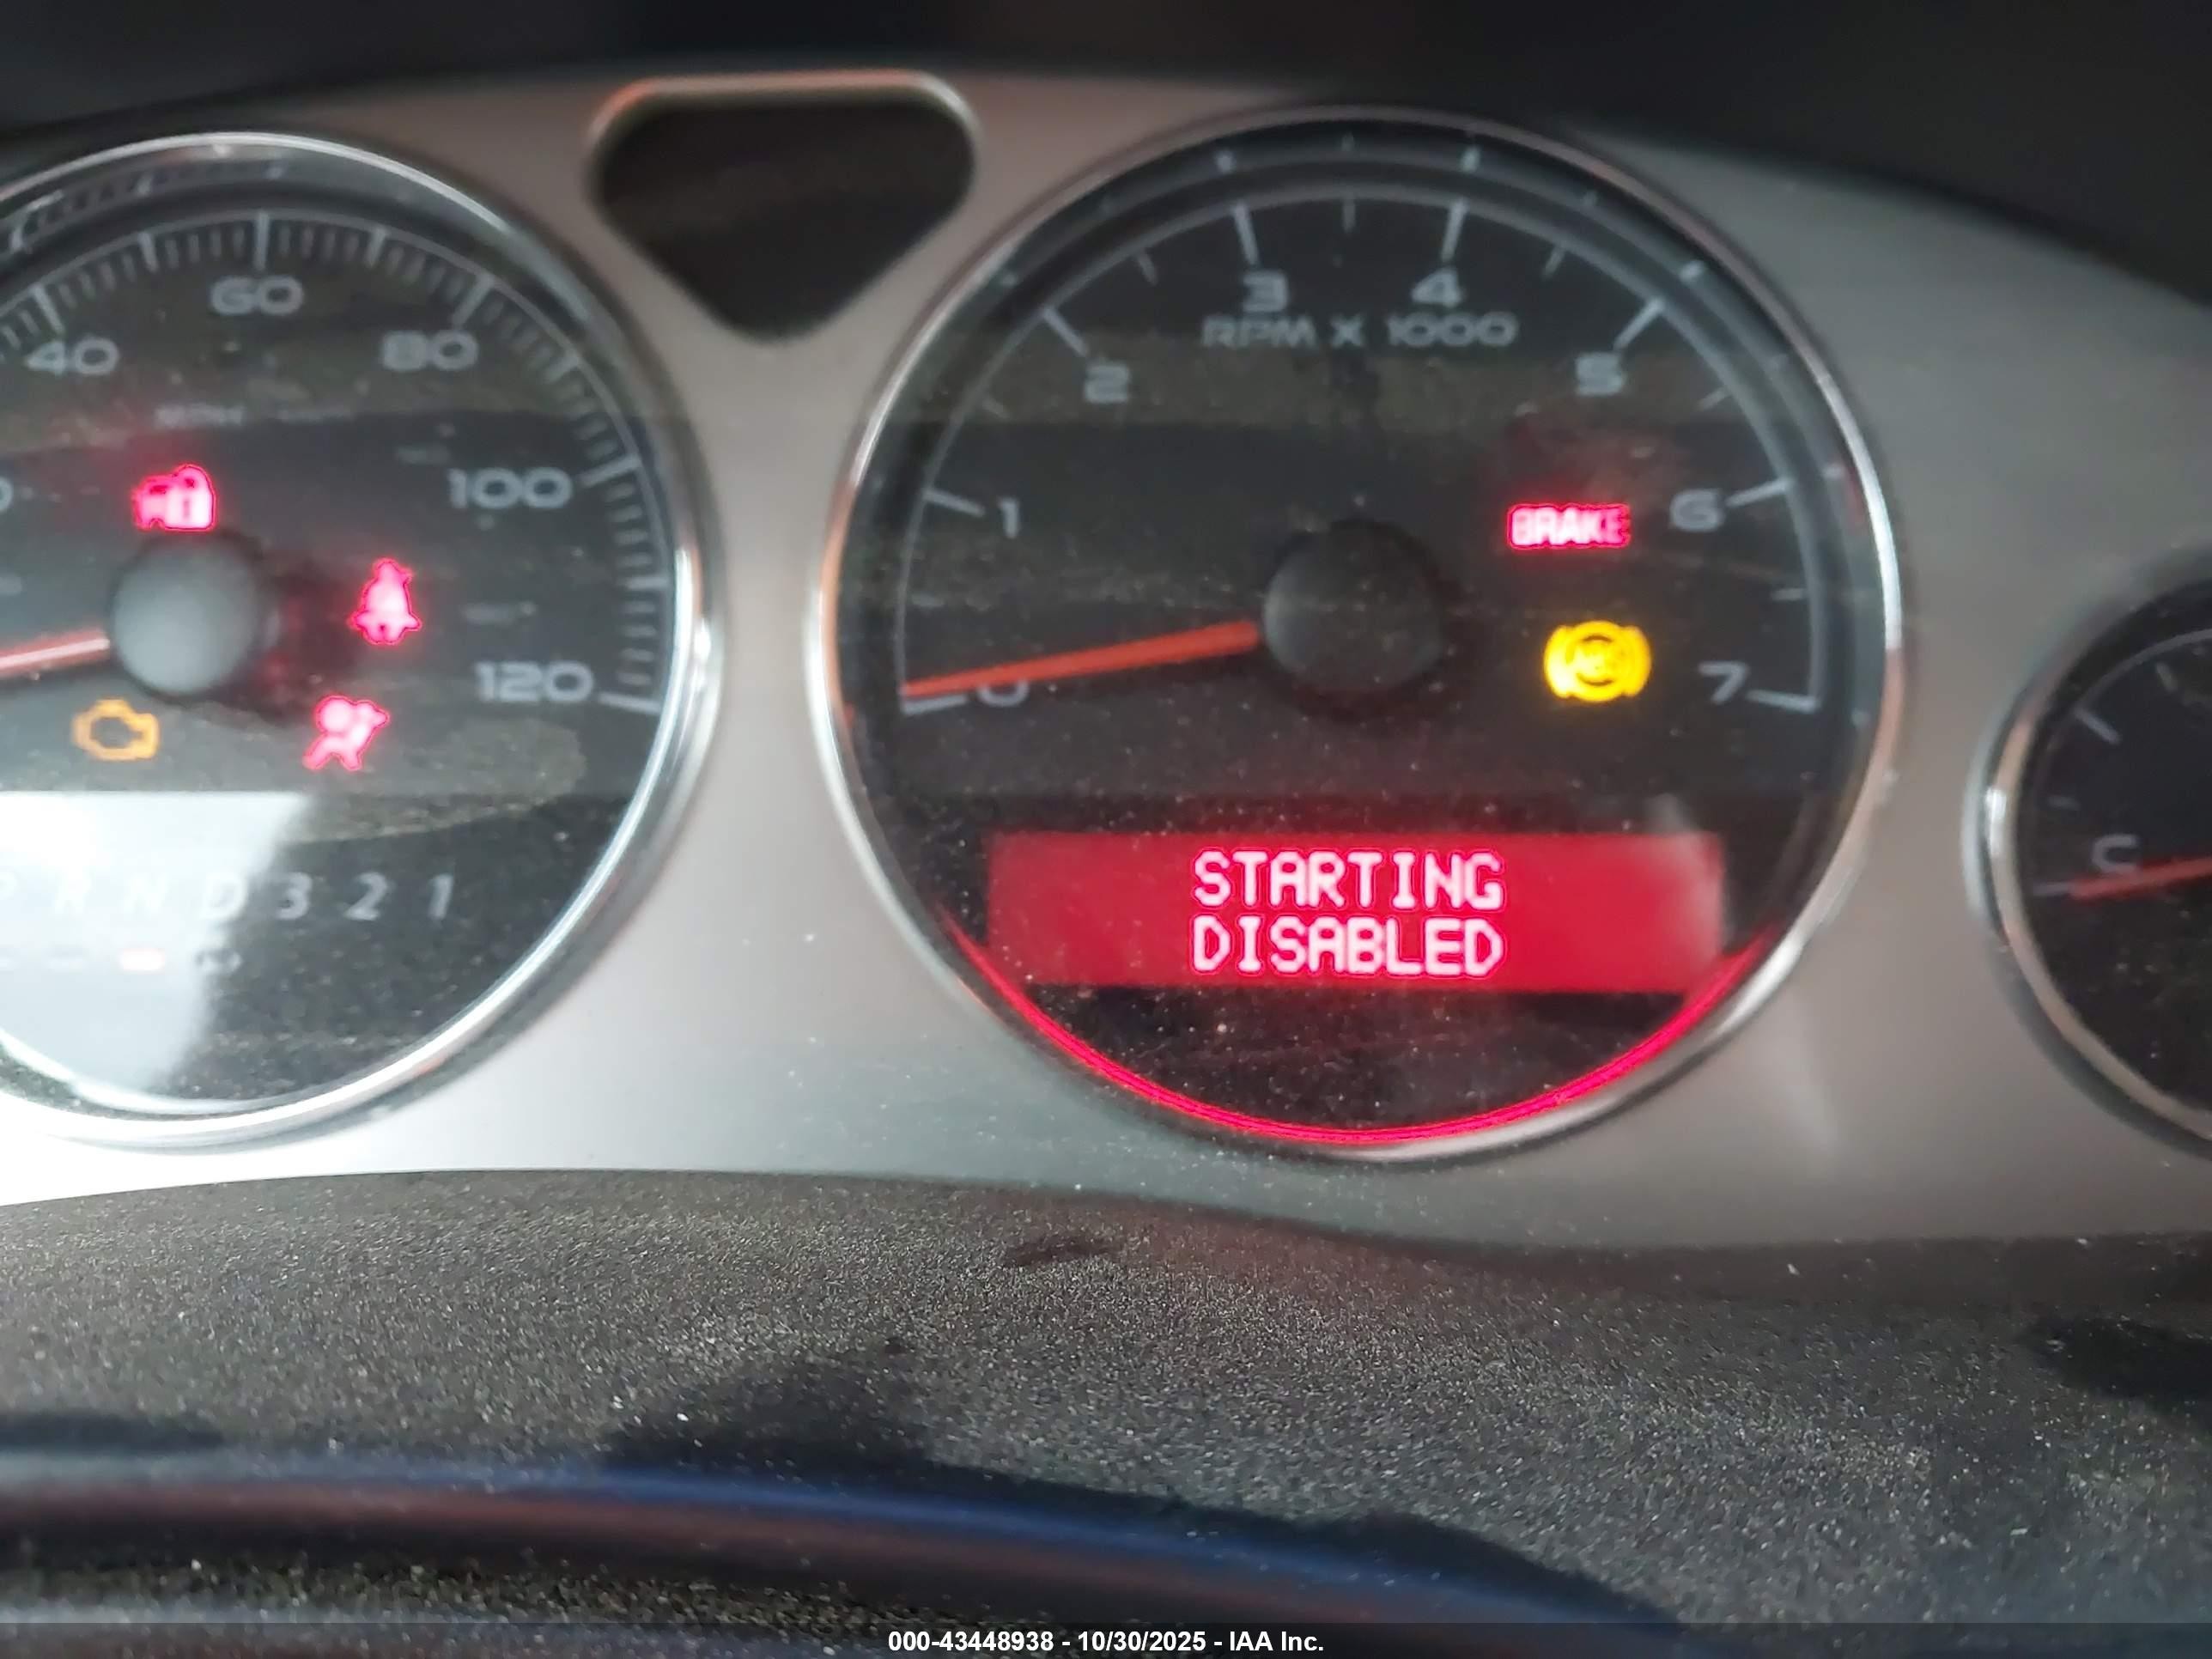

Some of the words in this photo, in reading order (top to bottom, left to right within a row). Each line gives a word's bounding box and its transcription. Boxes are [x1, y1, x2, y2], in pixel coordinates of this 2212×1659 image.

[209, 275, 305, 315] 60
[1242, 271, 1288, 313] 3
[1410, 268, 1462, 307] 4
[380, 329, 479, 372] 80
[1203, 314, 1317, 348] RPM
[1331, 313, 1365, 348] X
[1385, 311, 1518, 348] 1000
[27, 337, 118, 376] 40
[1575, 351, 1626, 397] 5
[1084, 362, 1130, 404] 2
[447, 466, 573, 510] 100
[997, 496, 1020, 539] 1
[1509, 504, 1630, 548] BRAKE
[1669, 488, 1723, 532] 6
[475, 659, 594, 702] 120
[1698, 659, 1748, 704] 7
[198, 871, 247, 920] D
[278, 872, 313, 920] 3
[344, 872, 389, 921] 2
[431, 873, 455, 921] 1
[1193, 848, 1504, 908] STARTING
[1191, 914, 1504, 976] DISABLED
